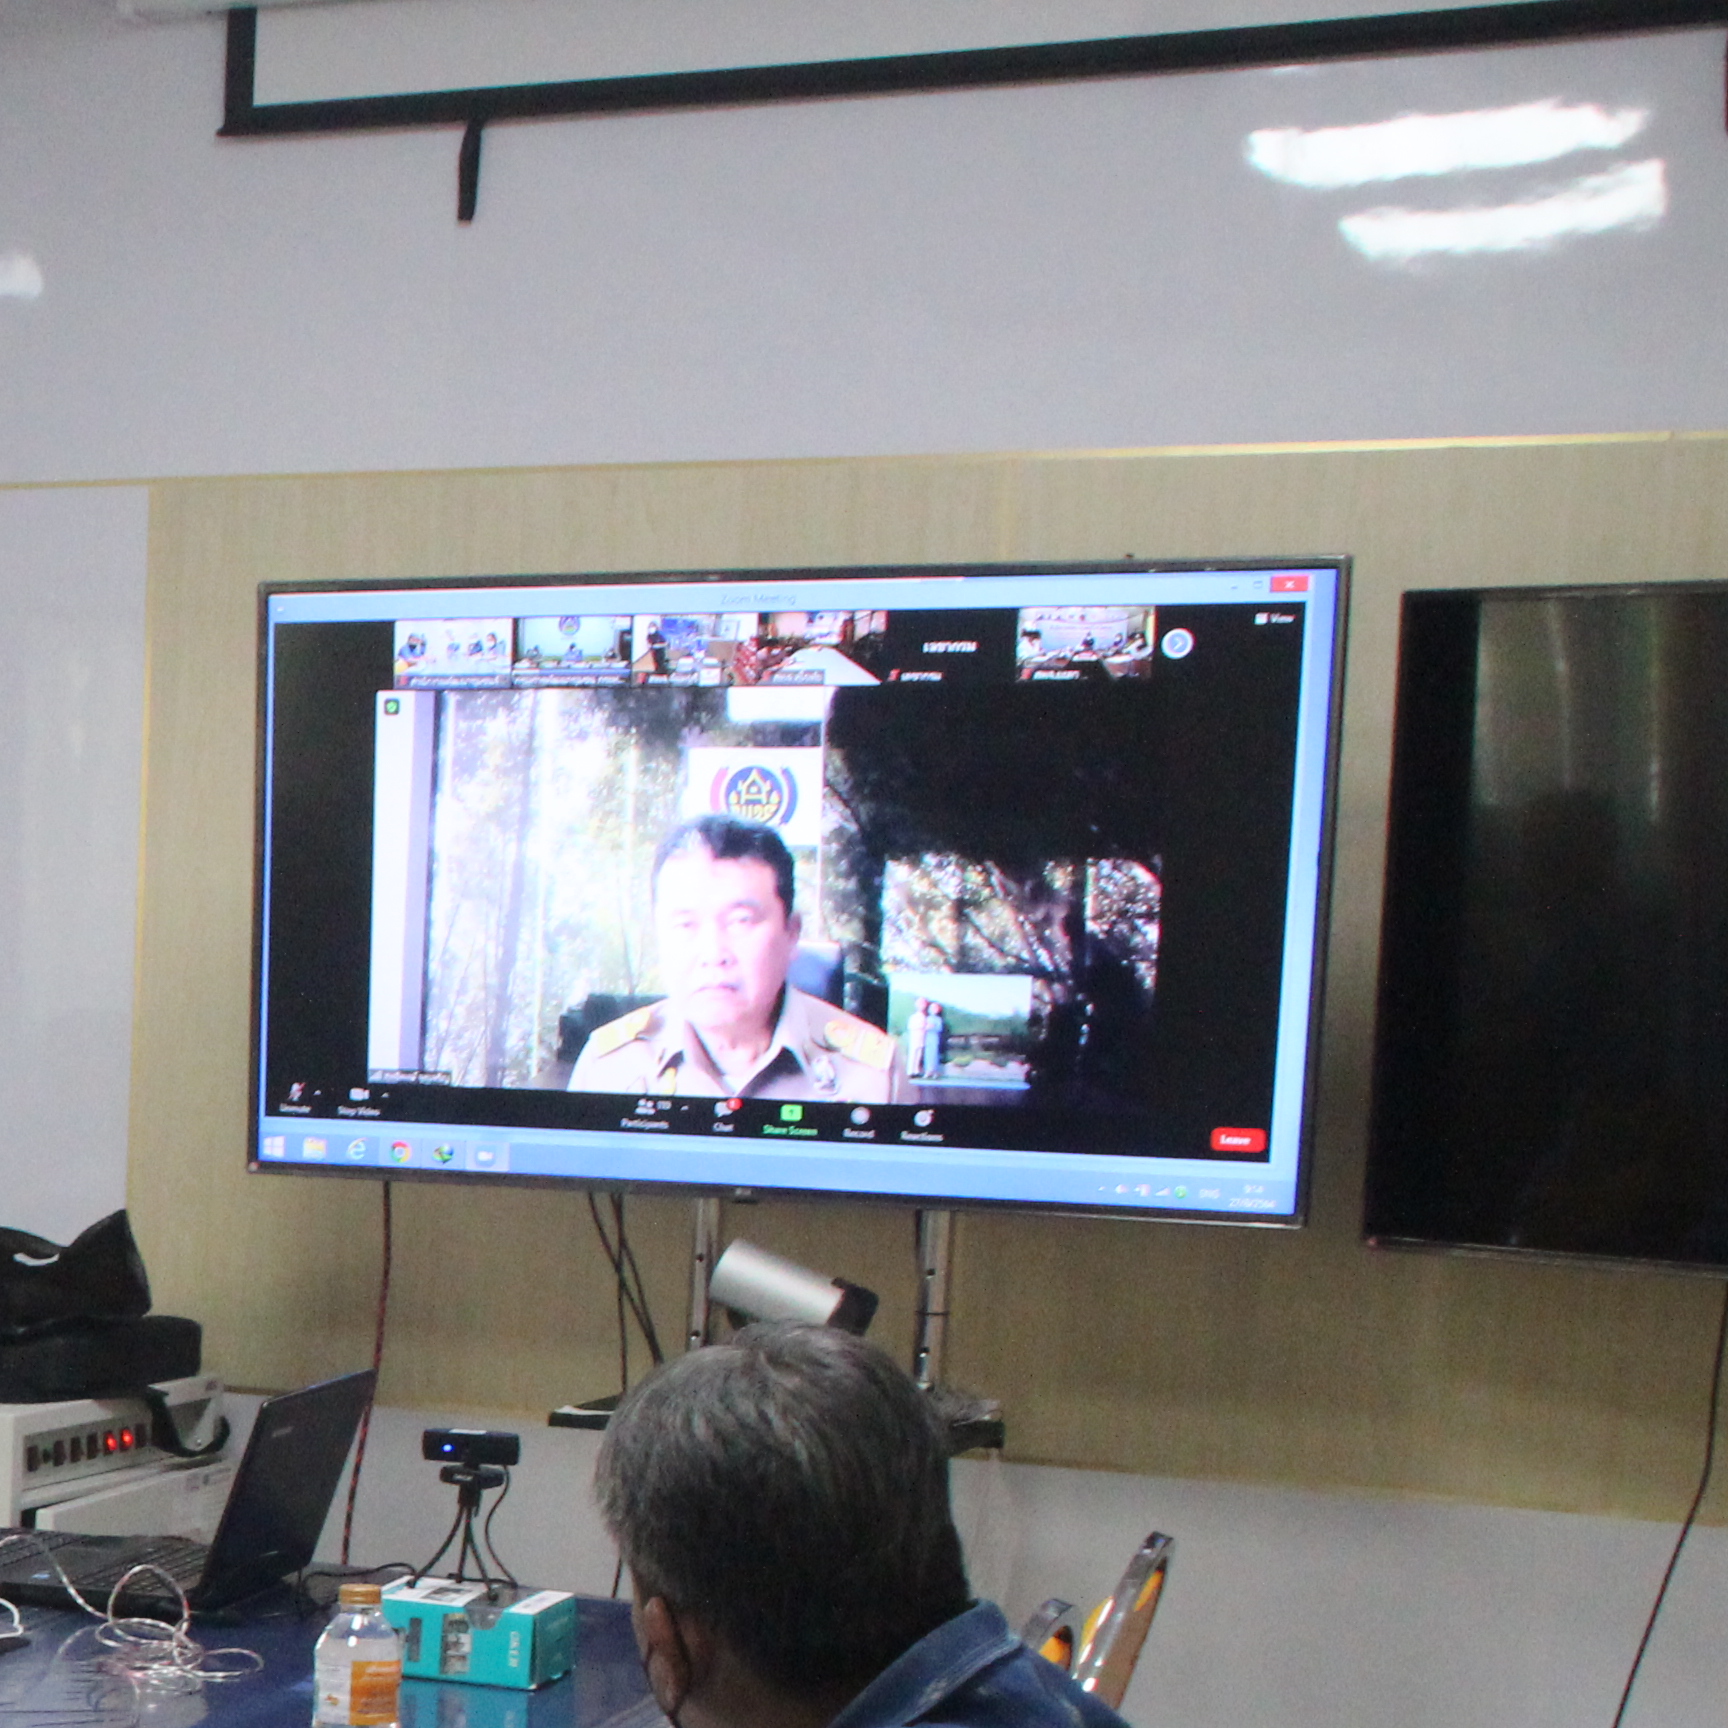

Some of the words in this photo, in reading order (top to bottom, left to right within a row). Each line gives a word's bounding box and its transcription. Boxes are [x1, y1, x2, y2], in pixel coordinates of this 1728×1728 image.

[1270, 612, 1295, 624] View
[762, 1124, 786, 1136] Share
[787, 1126, 819, 1137] Screen
[1220, 1134, 1251, 1145] Leave
